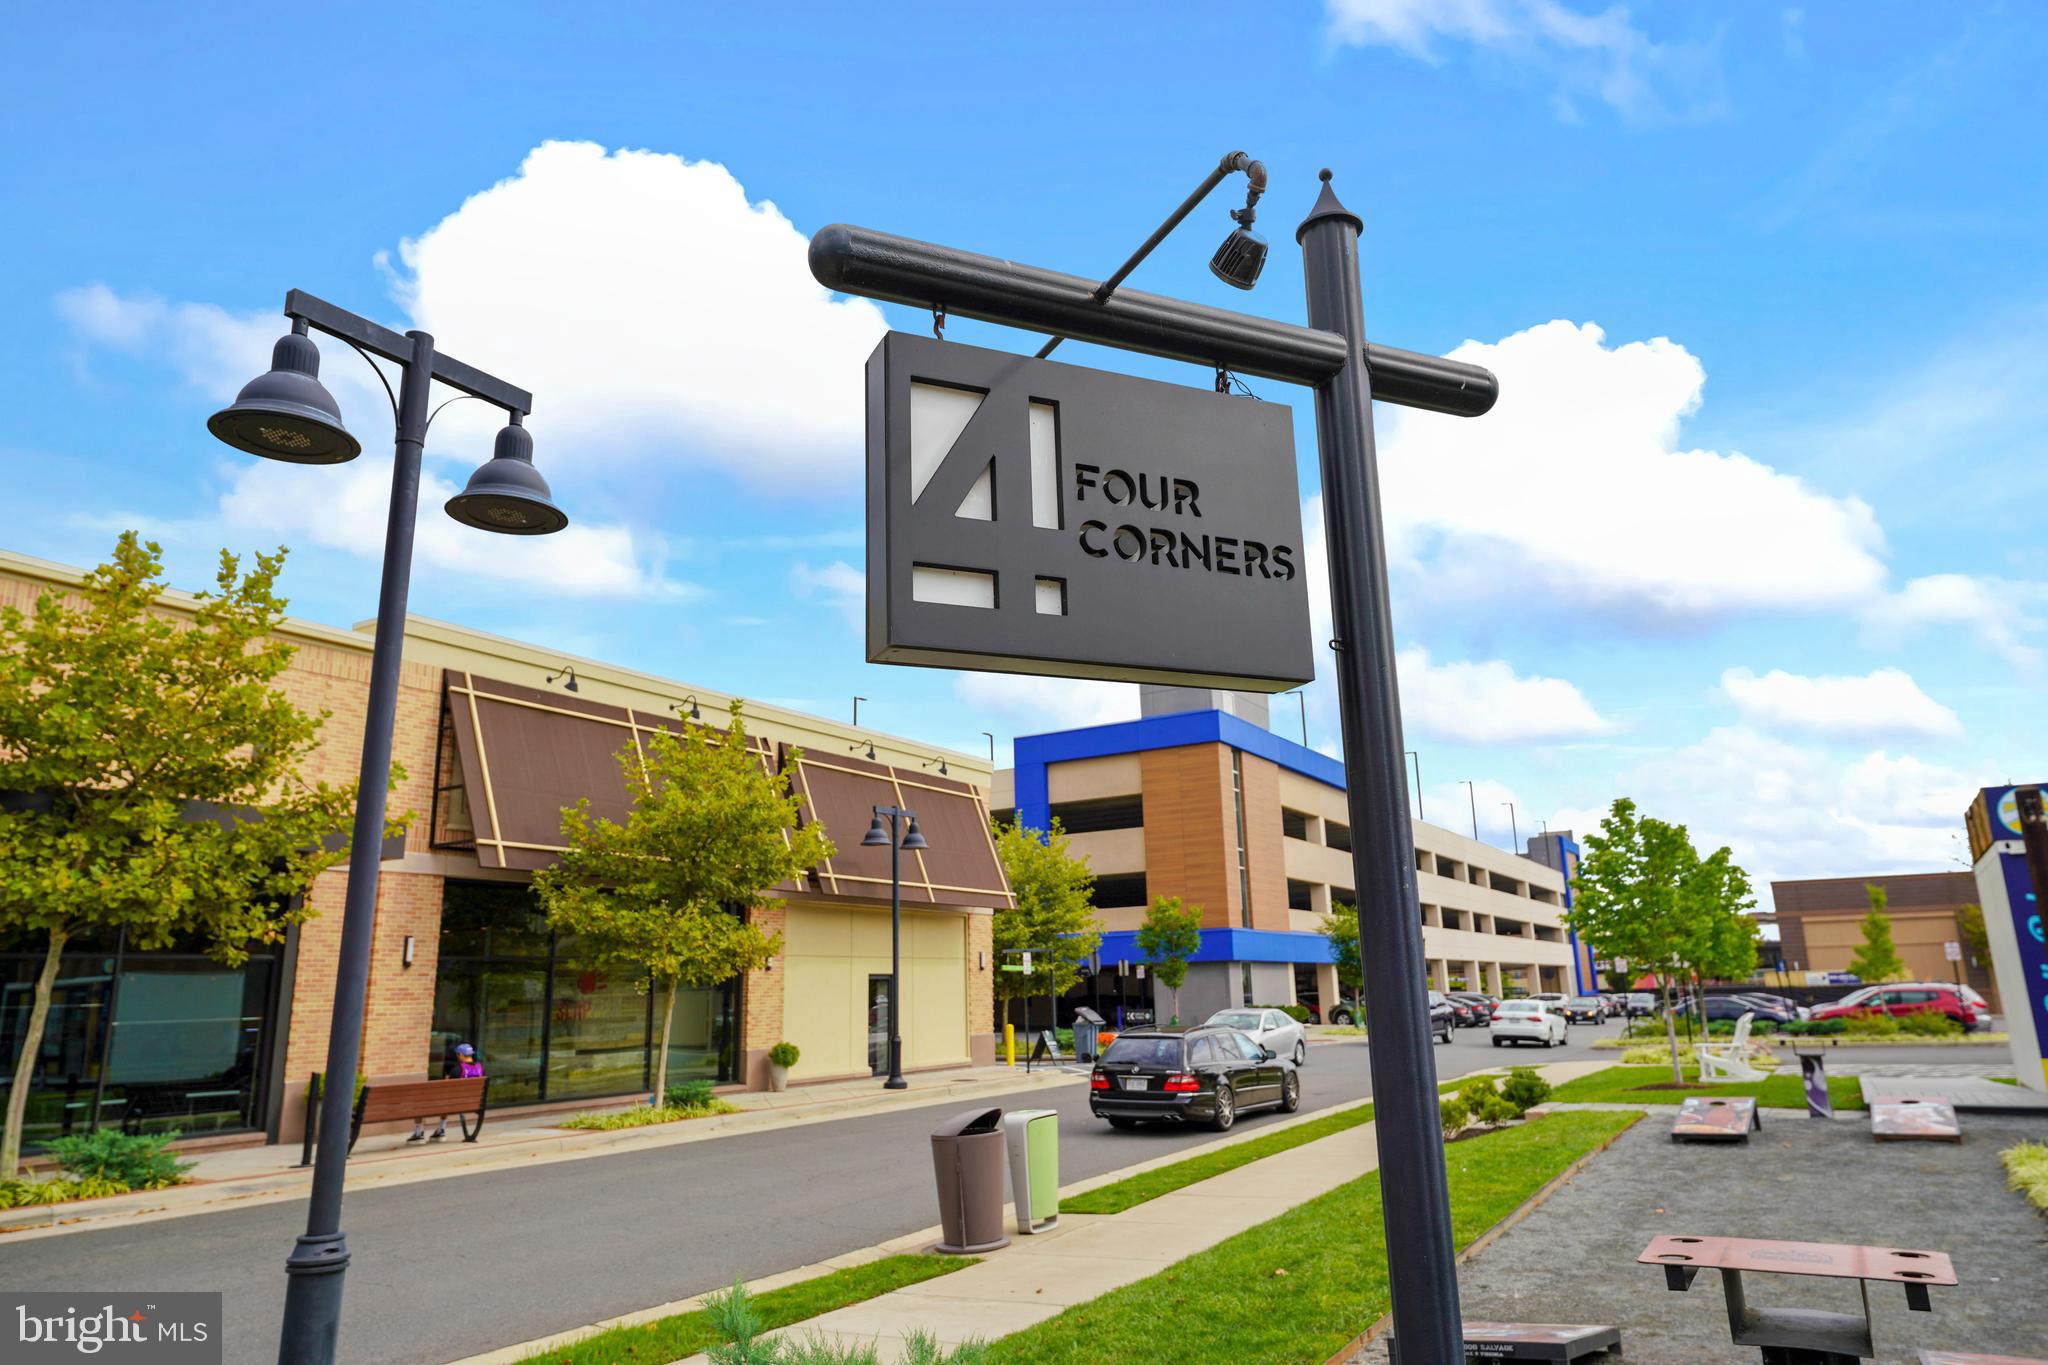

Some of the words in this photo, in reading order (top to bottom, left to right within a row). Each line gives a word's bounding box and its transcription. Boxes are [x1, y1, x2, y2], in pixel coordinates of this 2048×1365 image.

[911, 374, 1068, 616] 4
[1075, 463, 1202, 517] FOUR
[1078, 519, 1296, 582] CORNERS
